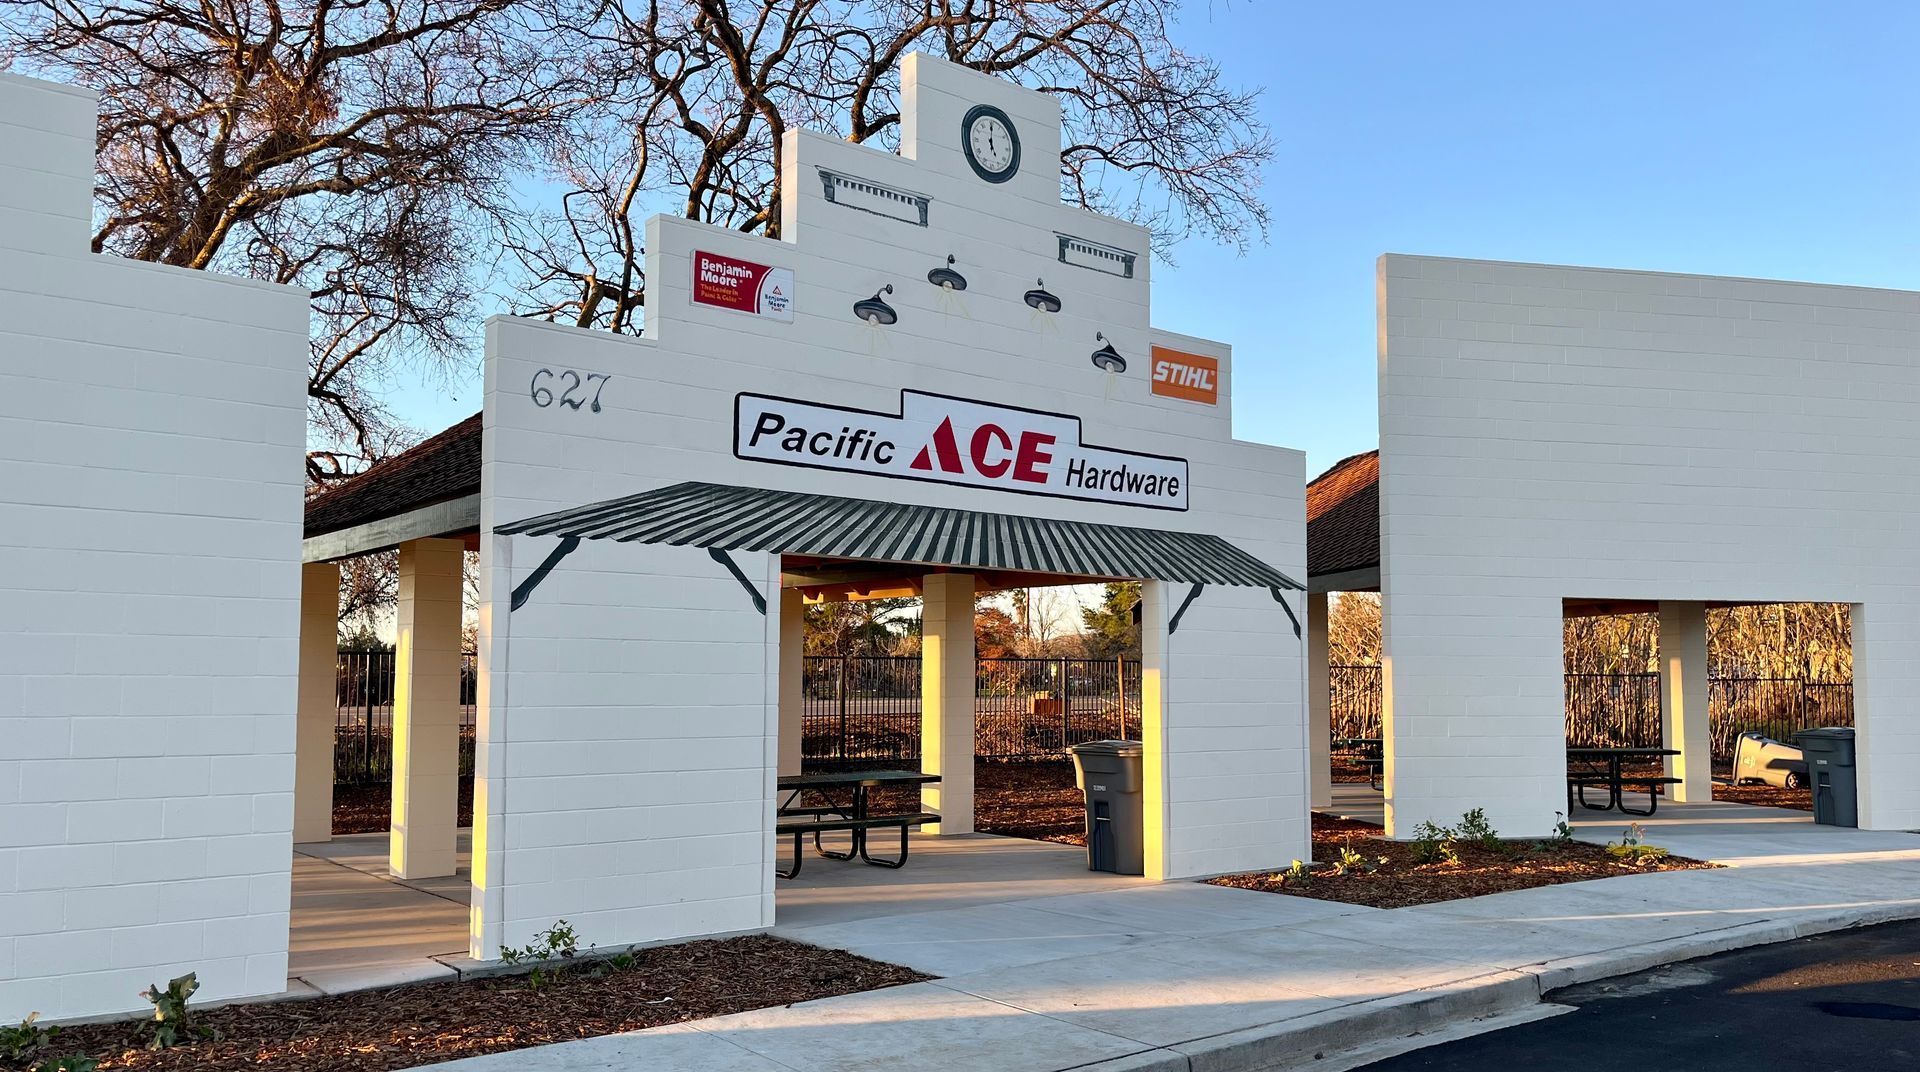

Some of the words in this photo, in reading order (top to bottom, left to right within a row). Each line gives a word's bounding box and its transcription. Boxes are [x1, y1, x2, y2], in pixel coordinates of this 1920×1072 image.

[701, 258, 753, 279] Benjamin
[701, 270, 738, 288] Moore
[701, 283, 711, 291] The
[1153, 360, 1214, 391] STIHL
[530, 368, 611, 414] 627
[749, 411, 896, 465] Pacific
[909, 415, 1055, 484] ACE
[1066, 458, 1180, 498] Hardware
